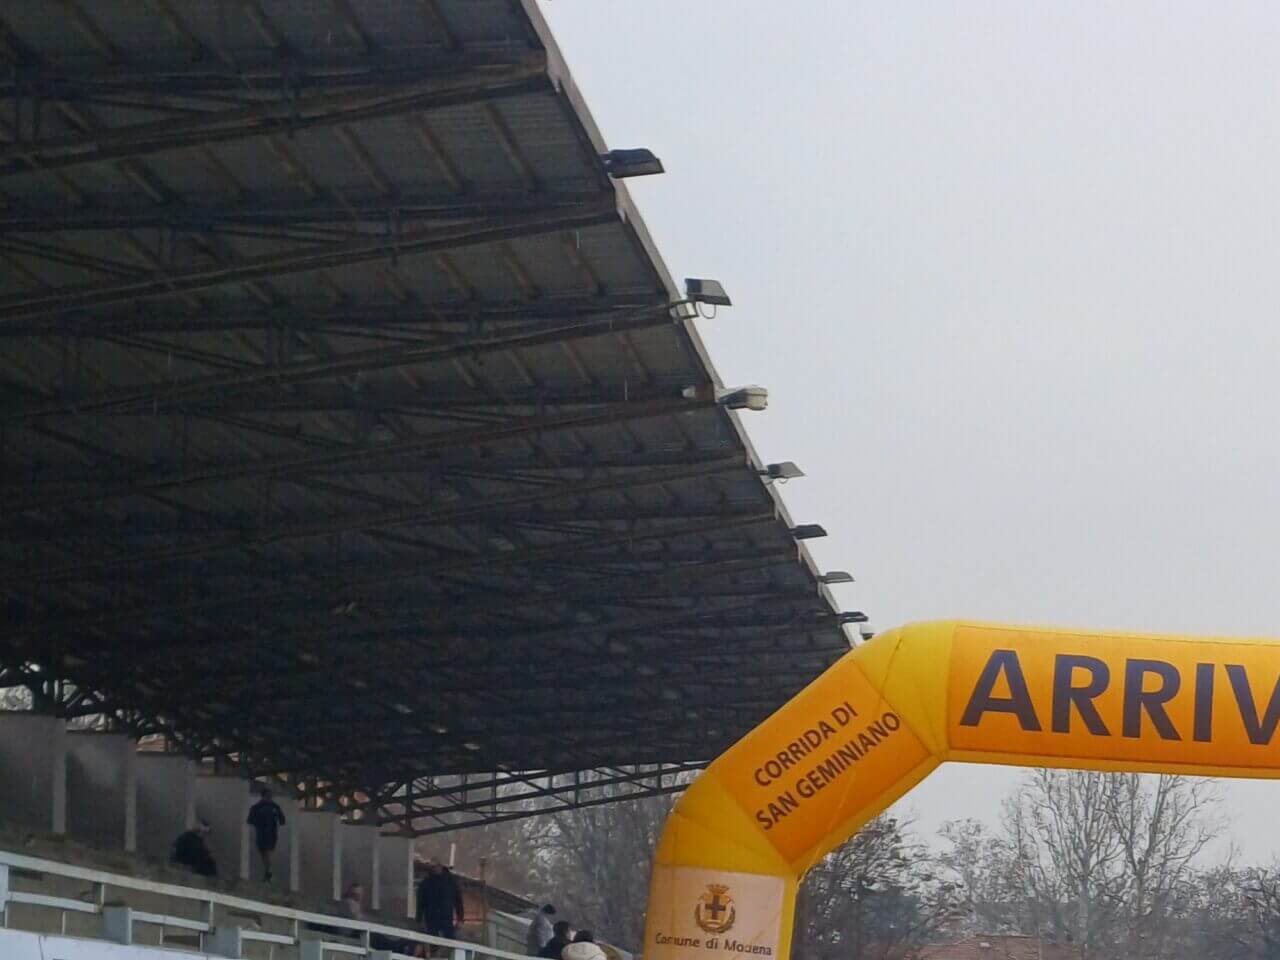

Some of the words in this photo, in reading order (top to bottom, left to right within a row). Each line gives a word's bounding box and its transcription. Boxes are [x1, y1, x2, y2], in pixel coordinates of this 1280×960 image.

[754, 720, 836, 787] CORRIDA
[831, 702, 859, 727] DI
[756, 791, 801, 831] SAN
[795, 711, 901, 799] GEMINIANO
[655, 932, 700, 948] Comune
[705, 937, 718, 950] di
